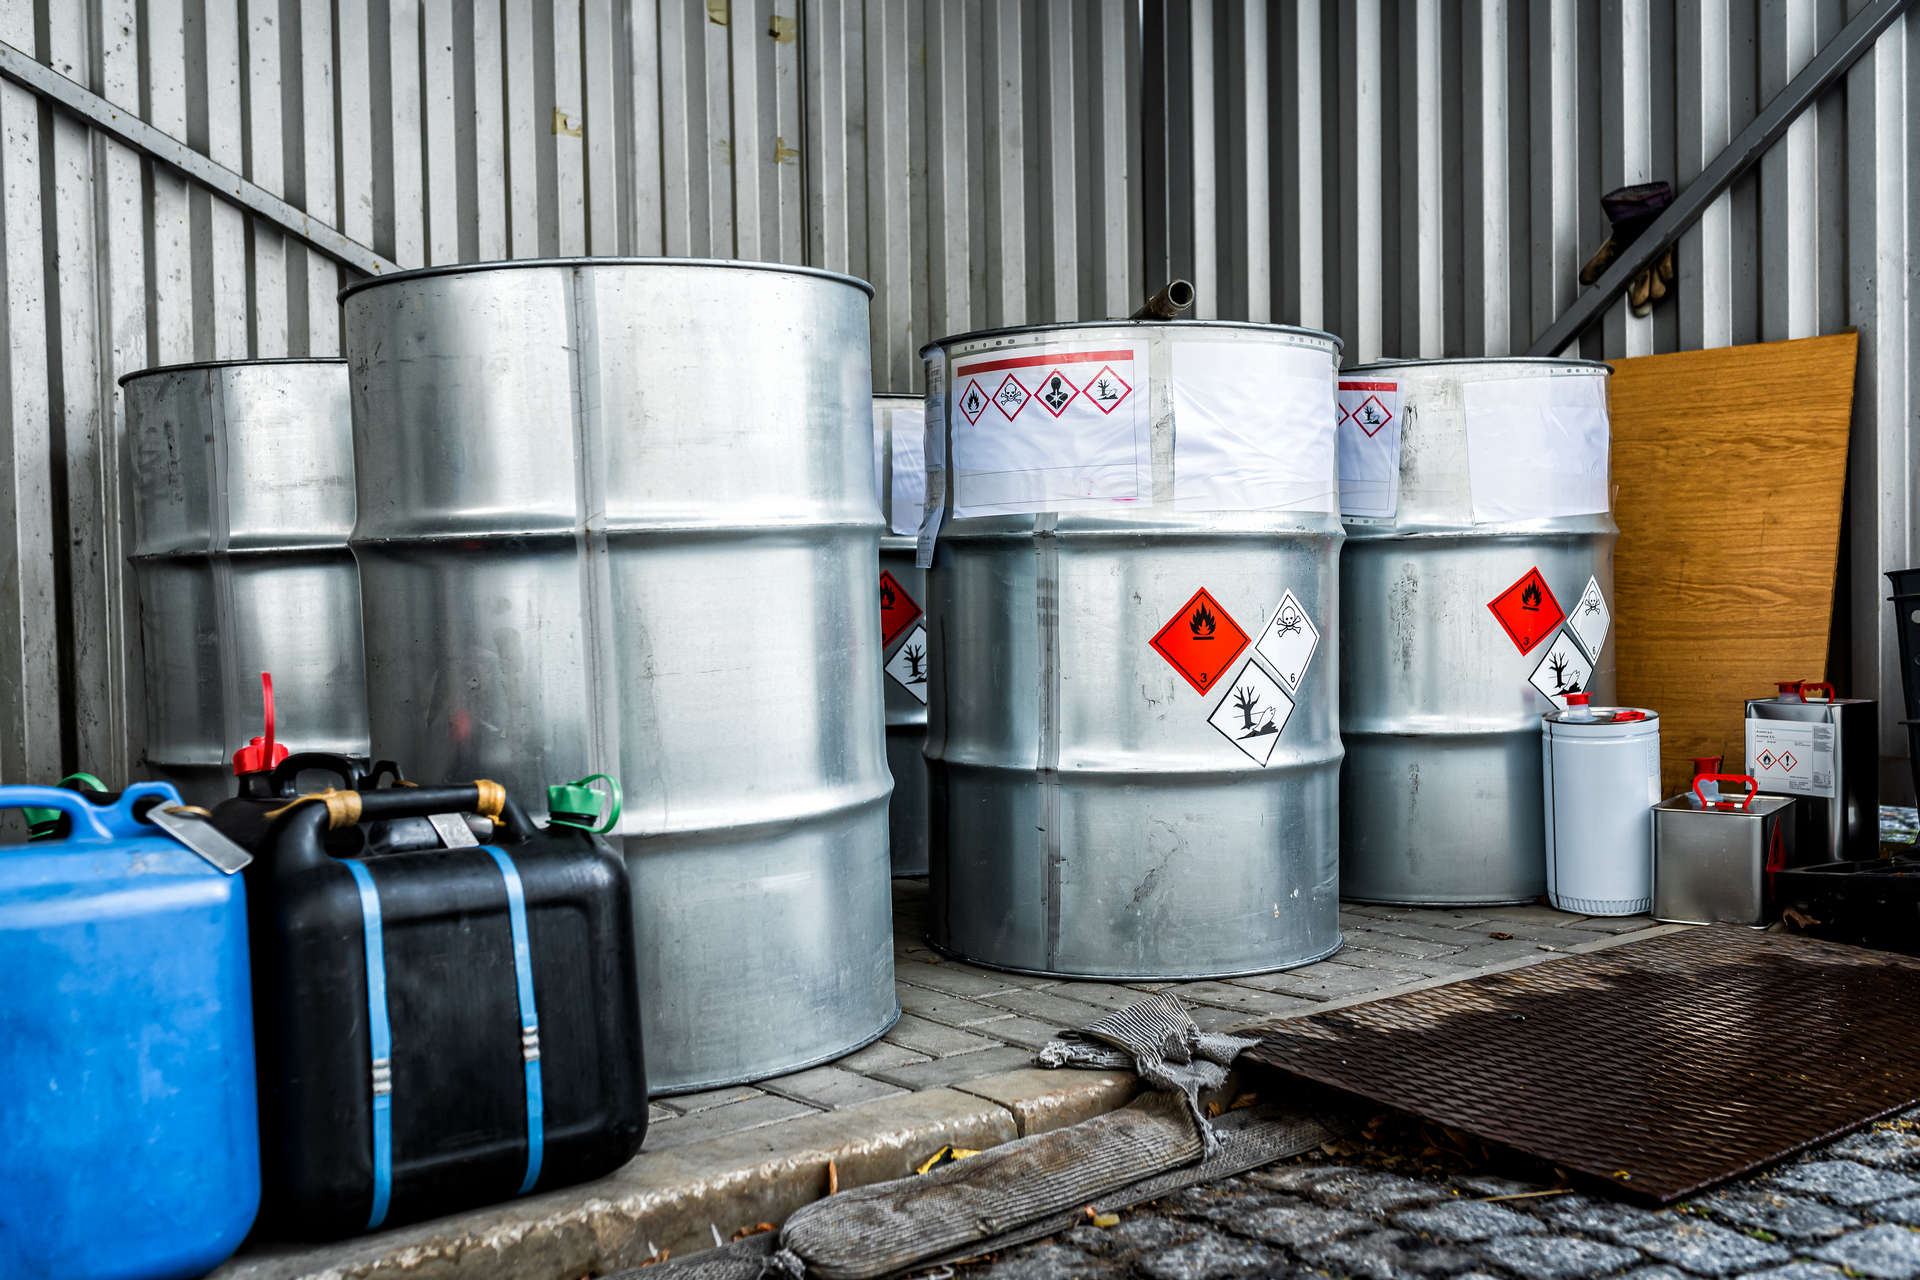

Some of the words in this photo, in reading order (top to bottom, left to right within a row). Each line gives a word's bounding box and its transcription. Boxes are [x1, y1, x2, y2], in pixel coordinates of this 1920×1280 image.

[1523, 636, 1530, 646] 3
[1200, 672, 1207, 683] 3
[1290, 672, 1296, 683] 6
